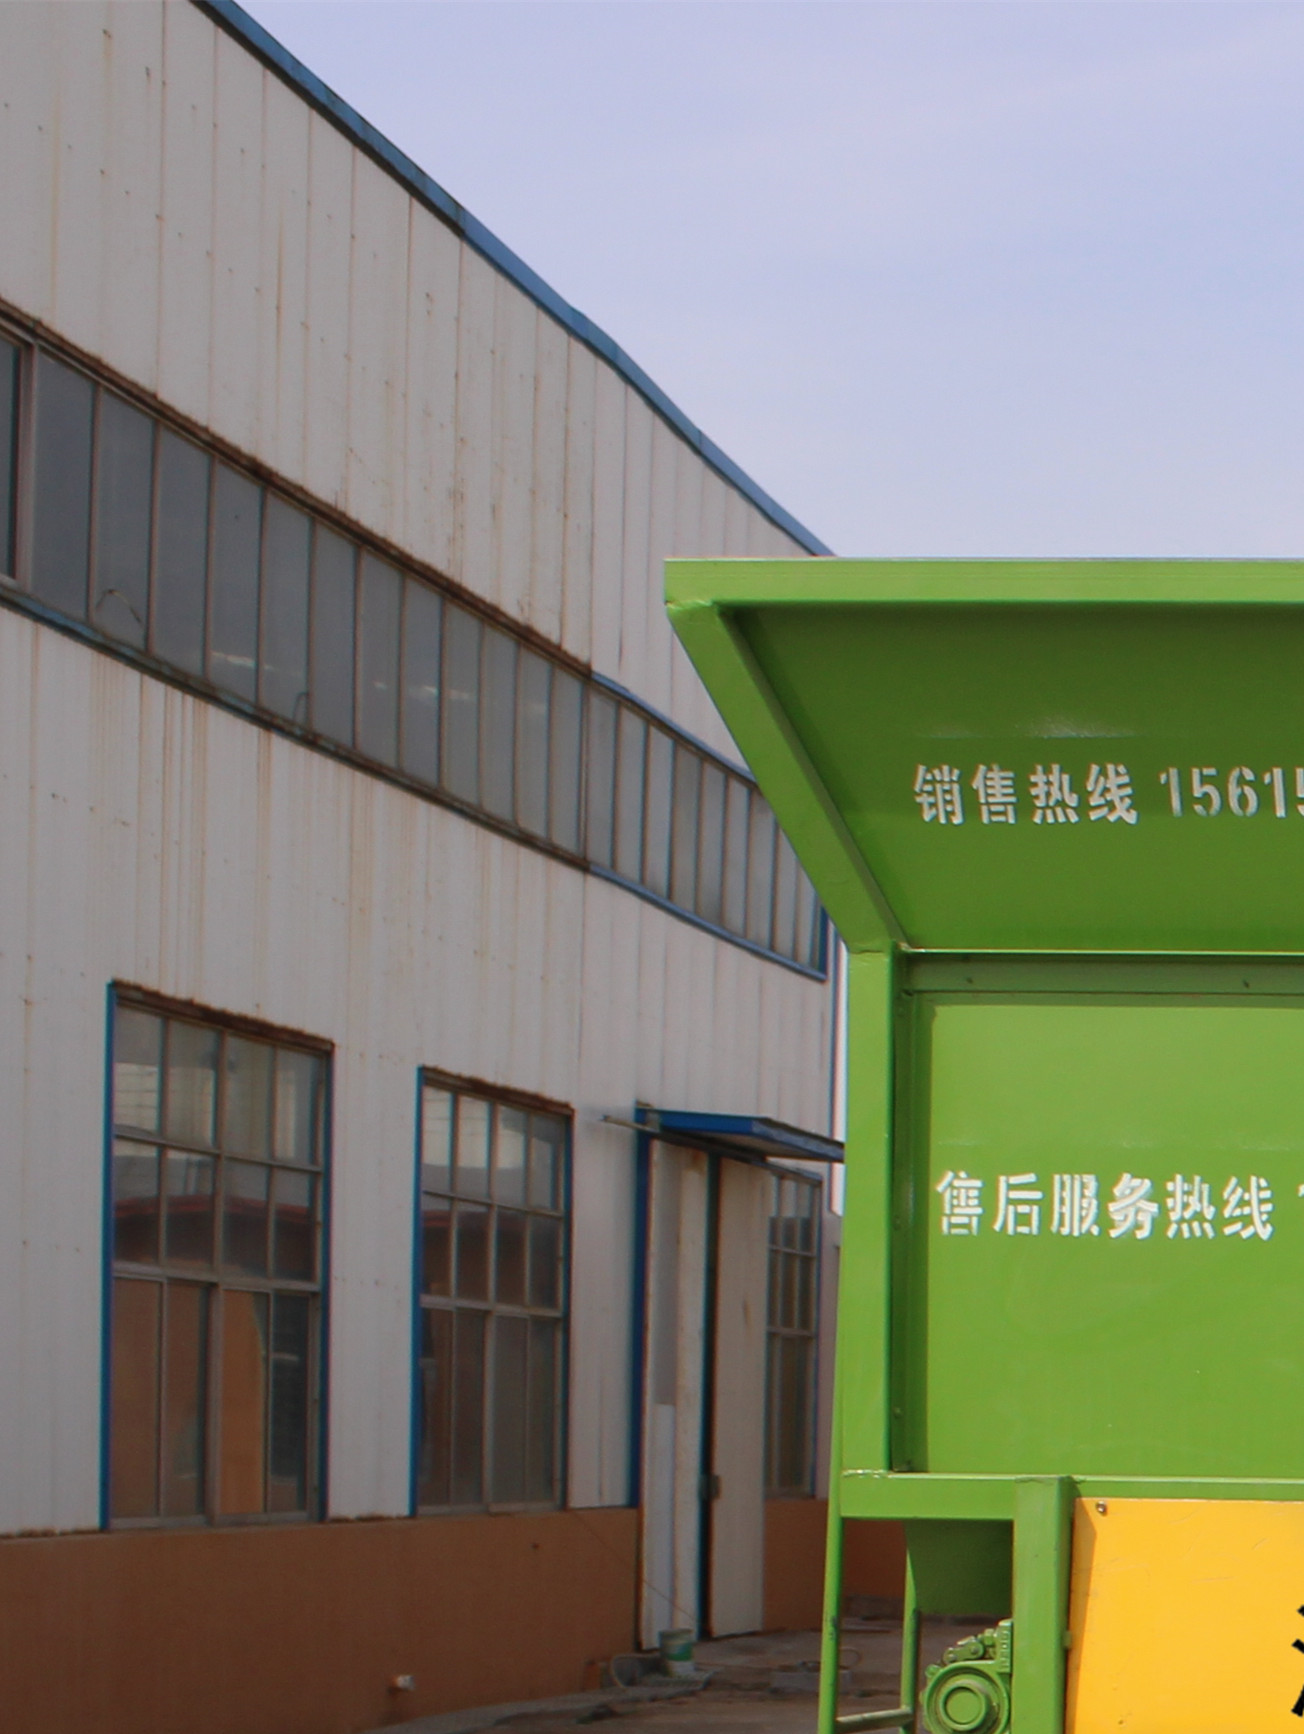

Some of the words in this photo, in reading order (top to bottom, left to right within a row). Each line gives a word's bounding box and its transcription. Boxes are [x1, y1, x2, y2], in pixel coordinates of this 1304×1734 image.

[914, 764, 1138, 826] 销售热线
[935, 1169, 1275, 1242] 售后服务热线
